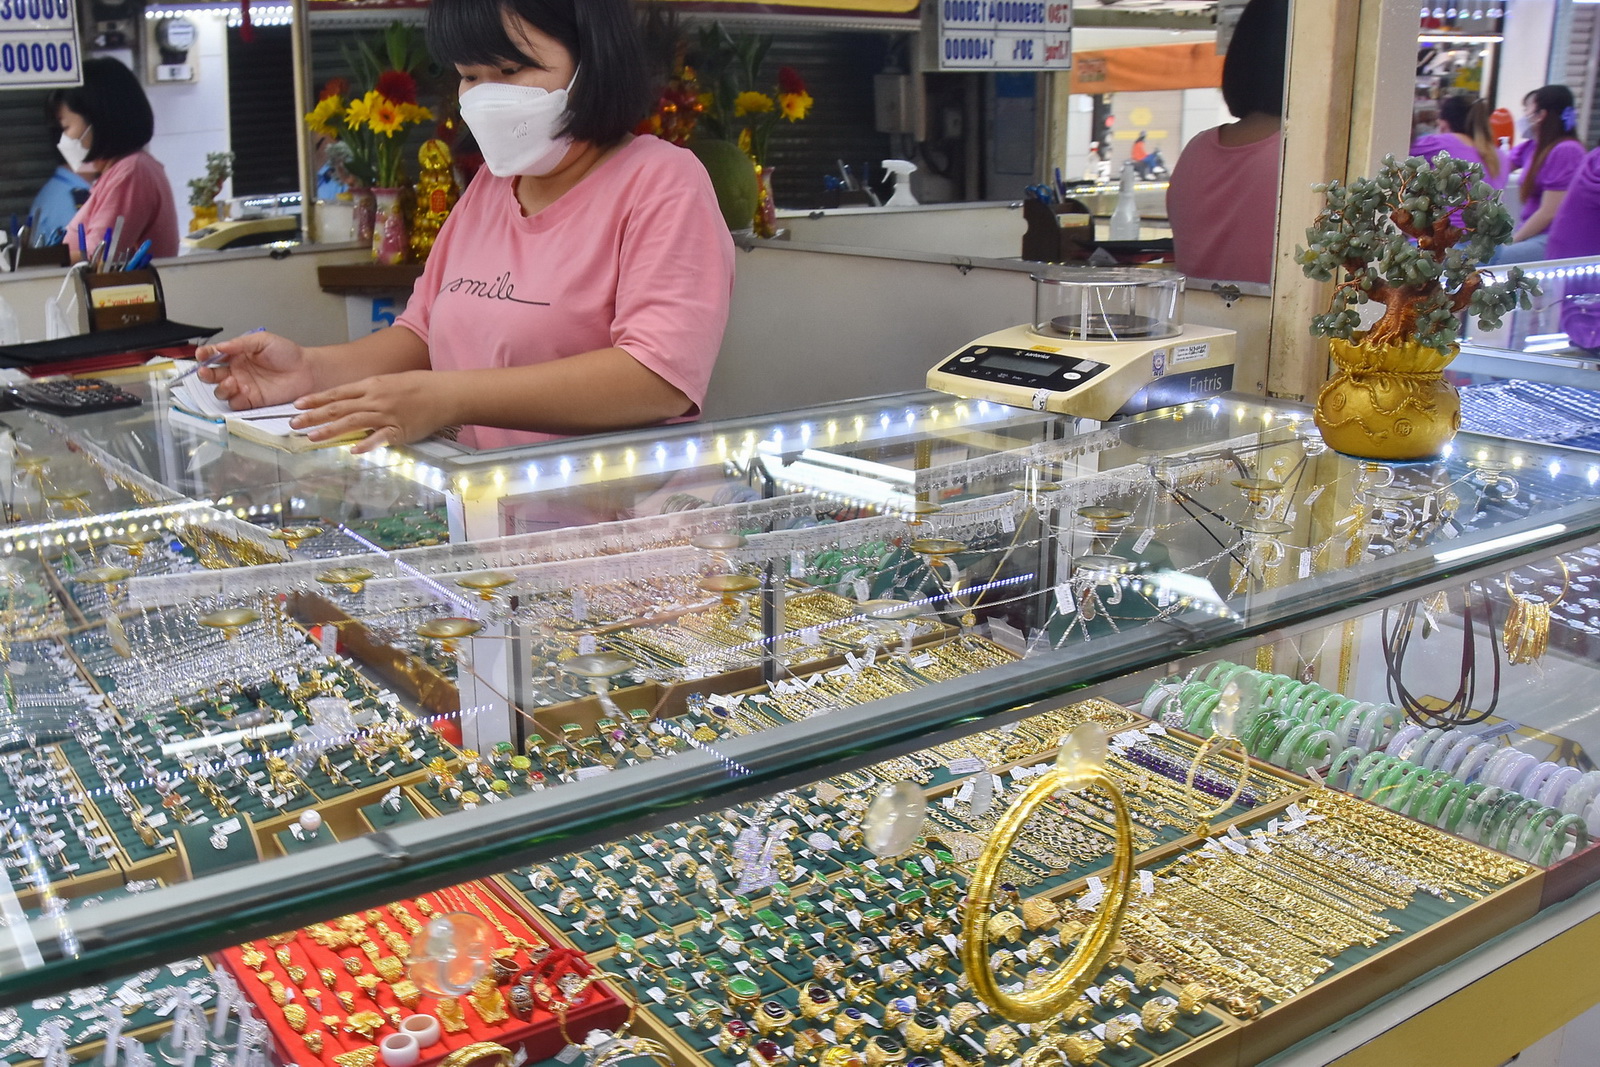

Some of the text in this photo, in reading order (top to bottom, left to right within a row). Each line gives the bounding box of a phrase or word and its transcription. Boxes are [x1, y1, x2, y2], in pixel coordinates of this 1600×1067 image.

[0, 42, 73, 73] 00000
[439, 271, 551, 306] smile
[1189, 373, 1223, 394] Entris
